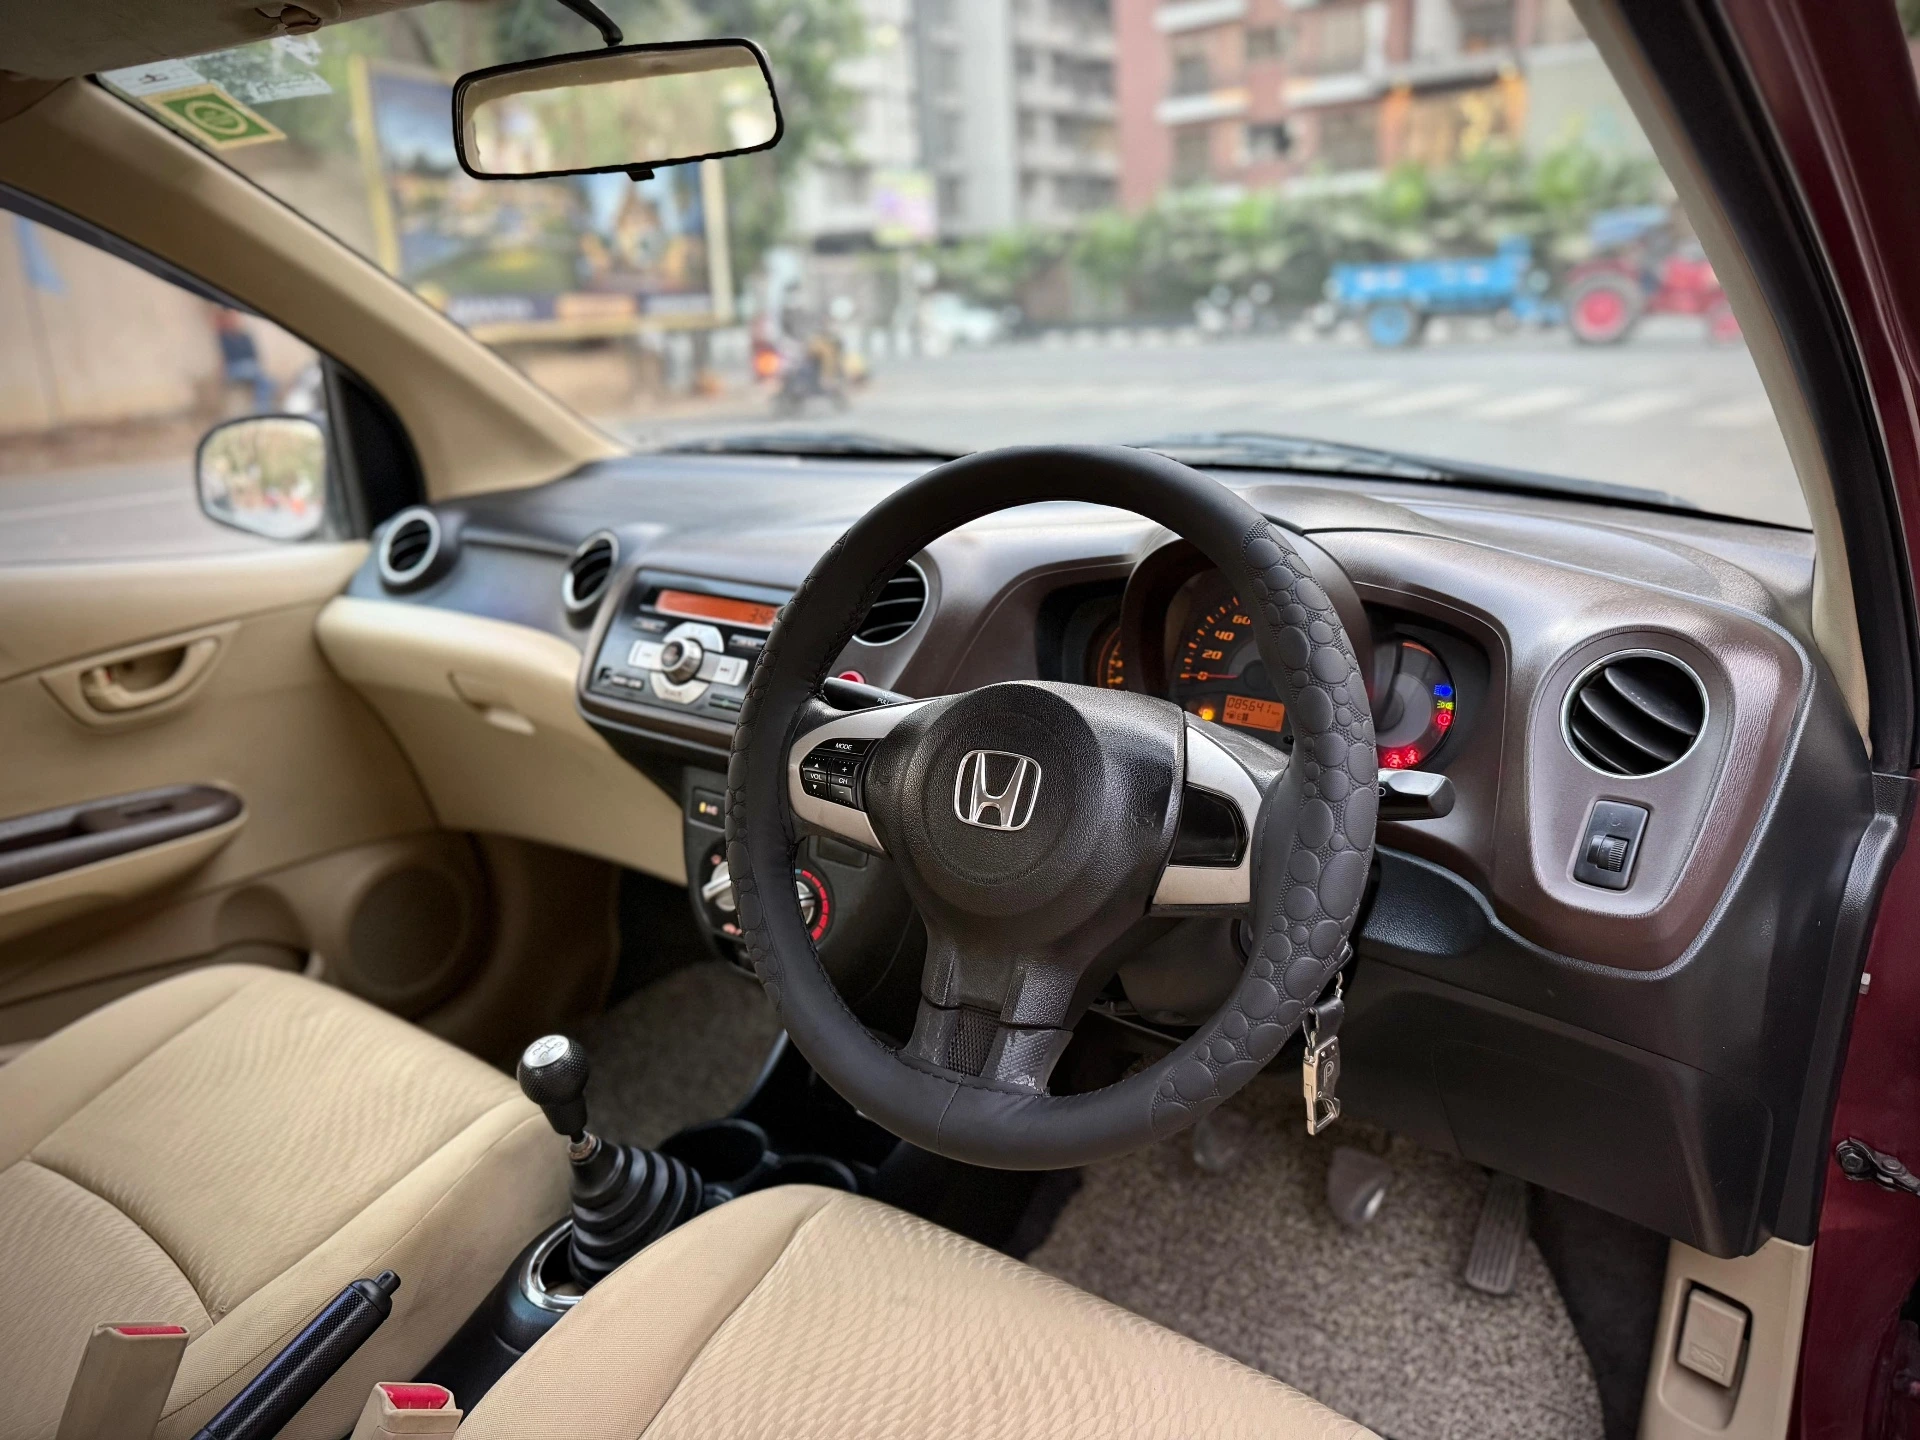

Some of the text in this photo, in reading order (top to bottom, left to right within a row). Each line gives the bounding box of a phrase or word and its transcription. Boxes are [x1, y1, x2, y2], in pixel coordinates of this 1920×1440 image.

[1232, 615, 1251, 625] 60
[1214, 630, 1235, 641] 40
[1201, 649, 1223, 660] 20
[1227, 698, 1272, 714] 085641
[835, 742, 853, 751] MODE
[838, 777, 848, 785] CH
